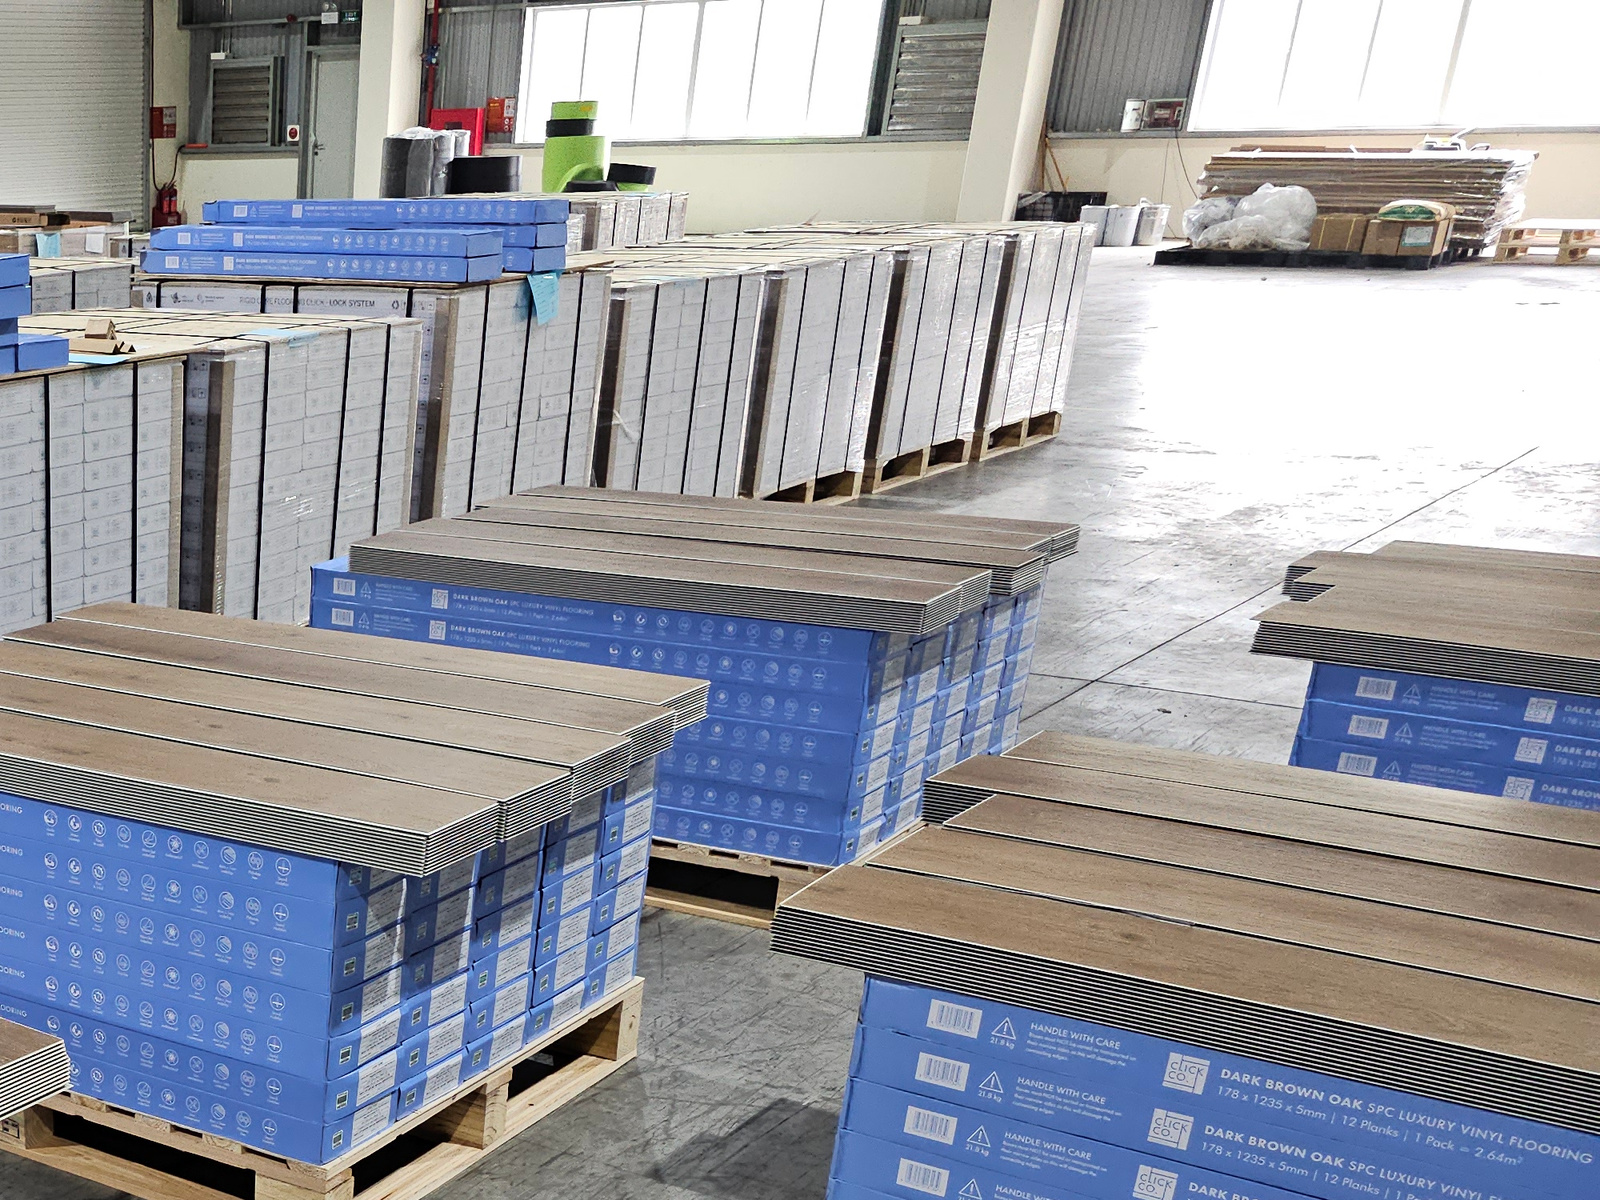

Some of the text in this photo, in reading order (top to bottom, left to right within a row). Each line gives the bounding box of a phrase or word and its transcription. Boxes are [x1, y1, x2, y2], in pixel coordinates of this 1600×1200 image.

[329, 298, 346, 306] LOCK
[348, 298, 375, 307] SYSTEM
[470, 595, 493, 603] BROWN
[1565, 705, 1592, 714] DARK
[1555, 745, 1582, 754] DARK
[1542, 784, 1600, 799] DARK BROW
[1030, 1022, 1120, 1050] HANDLE WITH CARE
[1171, 1062, 1204, 1076] CLICK
[1017, 1076, 1106, 1104] HANDLE WITH CARE
[1218, 1085, 1239, 1099] 178
[1254, 1094, 1282, 1109] 1235
[1295, 1104, 1326, 1119] 5mm
[1343, 1115, 1357, 1126] 12
[1359, 1119, 1398, 1136] Planks
[1425, 1135, 1454, 1149] Pack
[1220, 1068, 1592, 1163] DARK BROWN OAK SPC LUXURY VINYL FLOORING
[1155, 1117, 1188, 1133] CLICK
[1004, 1131, 1091, 1160] HANDLE WITH CARE
[1204, 1125, 1244, 1142] DARK
[1248, 1136, 1306, 1158] BROWN
[1310, 1152, 1344, 1168] OAK
[1348, 1161, 1375, 1175] SPC
[1379, 1168, 1436, 1189] LUXURY
[1202, 1142, 1222, 1155] 178
[1237, 1150, 1266, 1165] 1235
[1278, 1161, 1308, 1176] 5mm
[1325, 1172, 1339, 1184] 12
[1342, 1177, 1379, 1194] Planks
[1140, 1173, 1172, 1189] CLICK
[994, 1184, 1031, 1200] HANDLE
[1188, 1182, 1227, 1200] DARK
